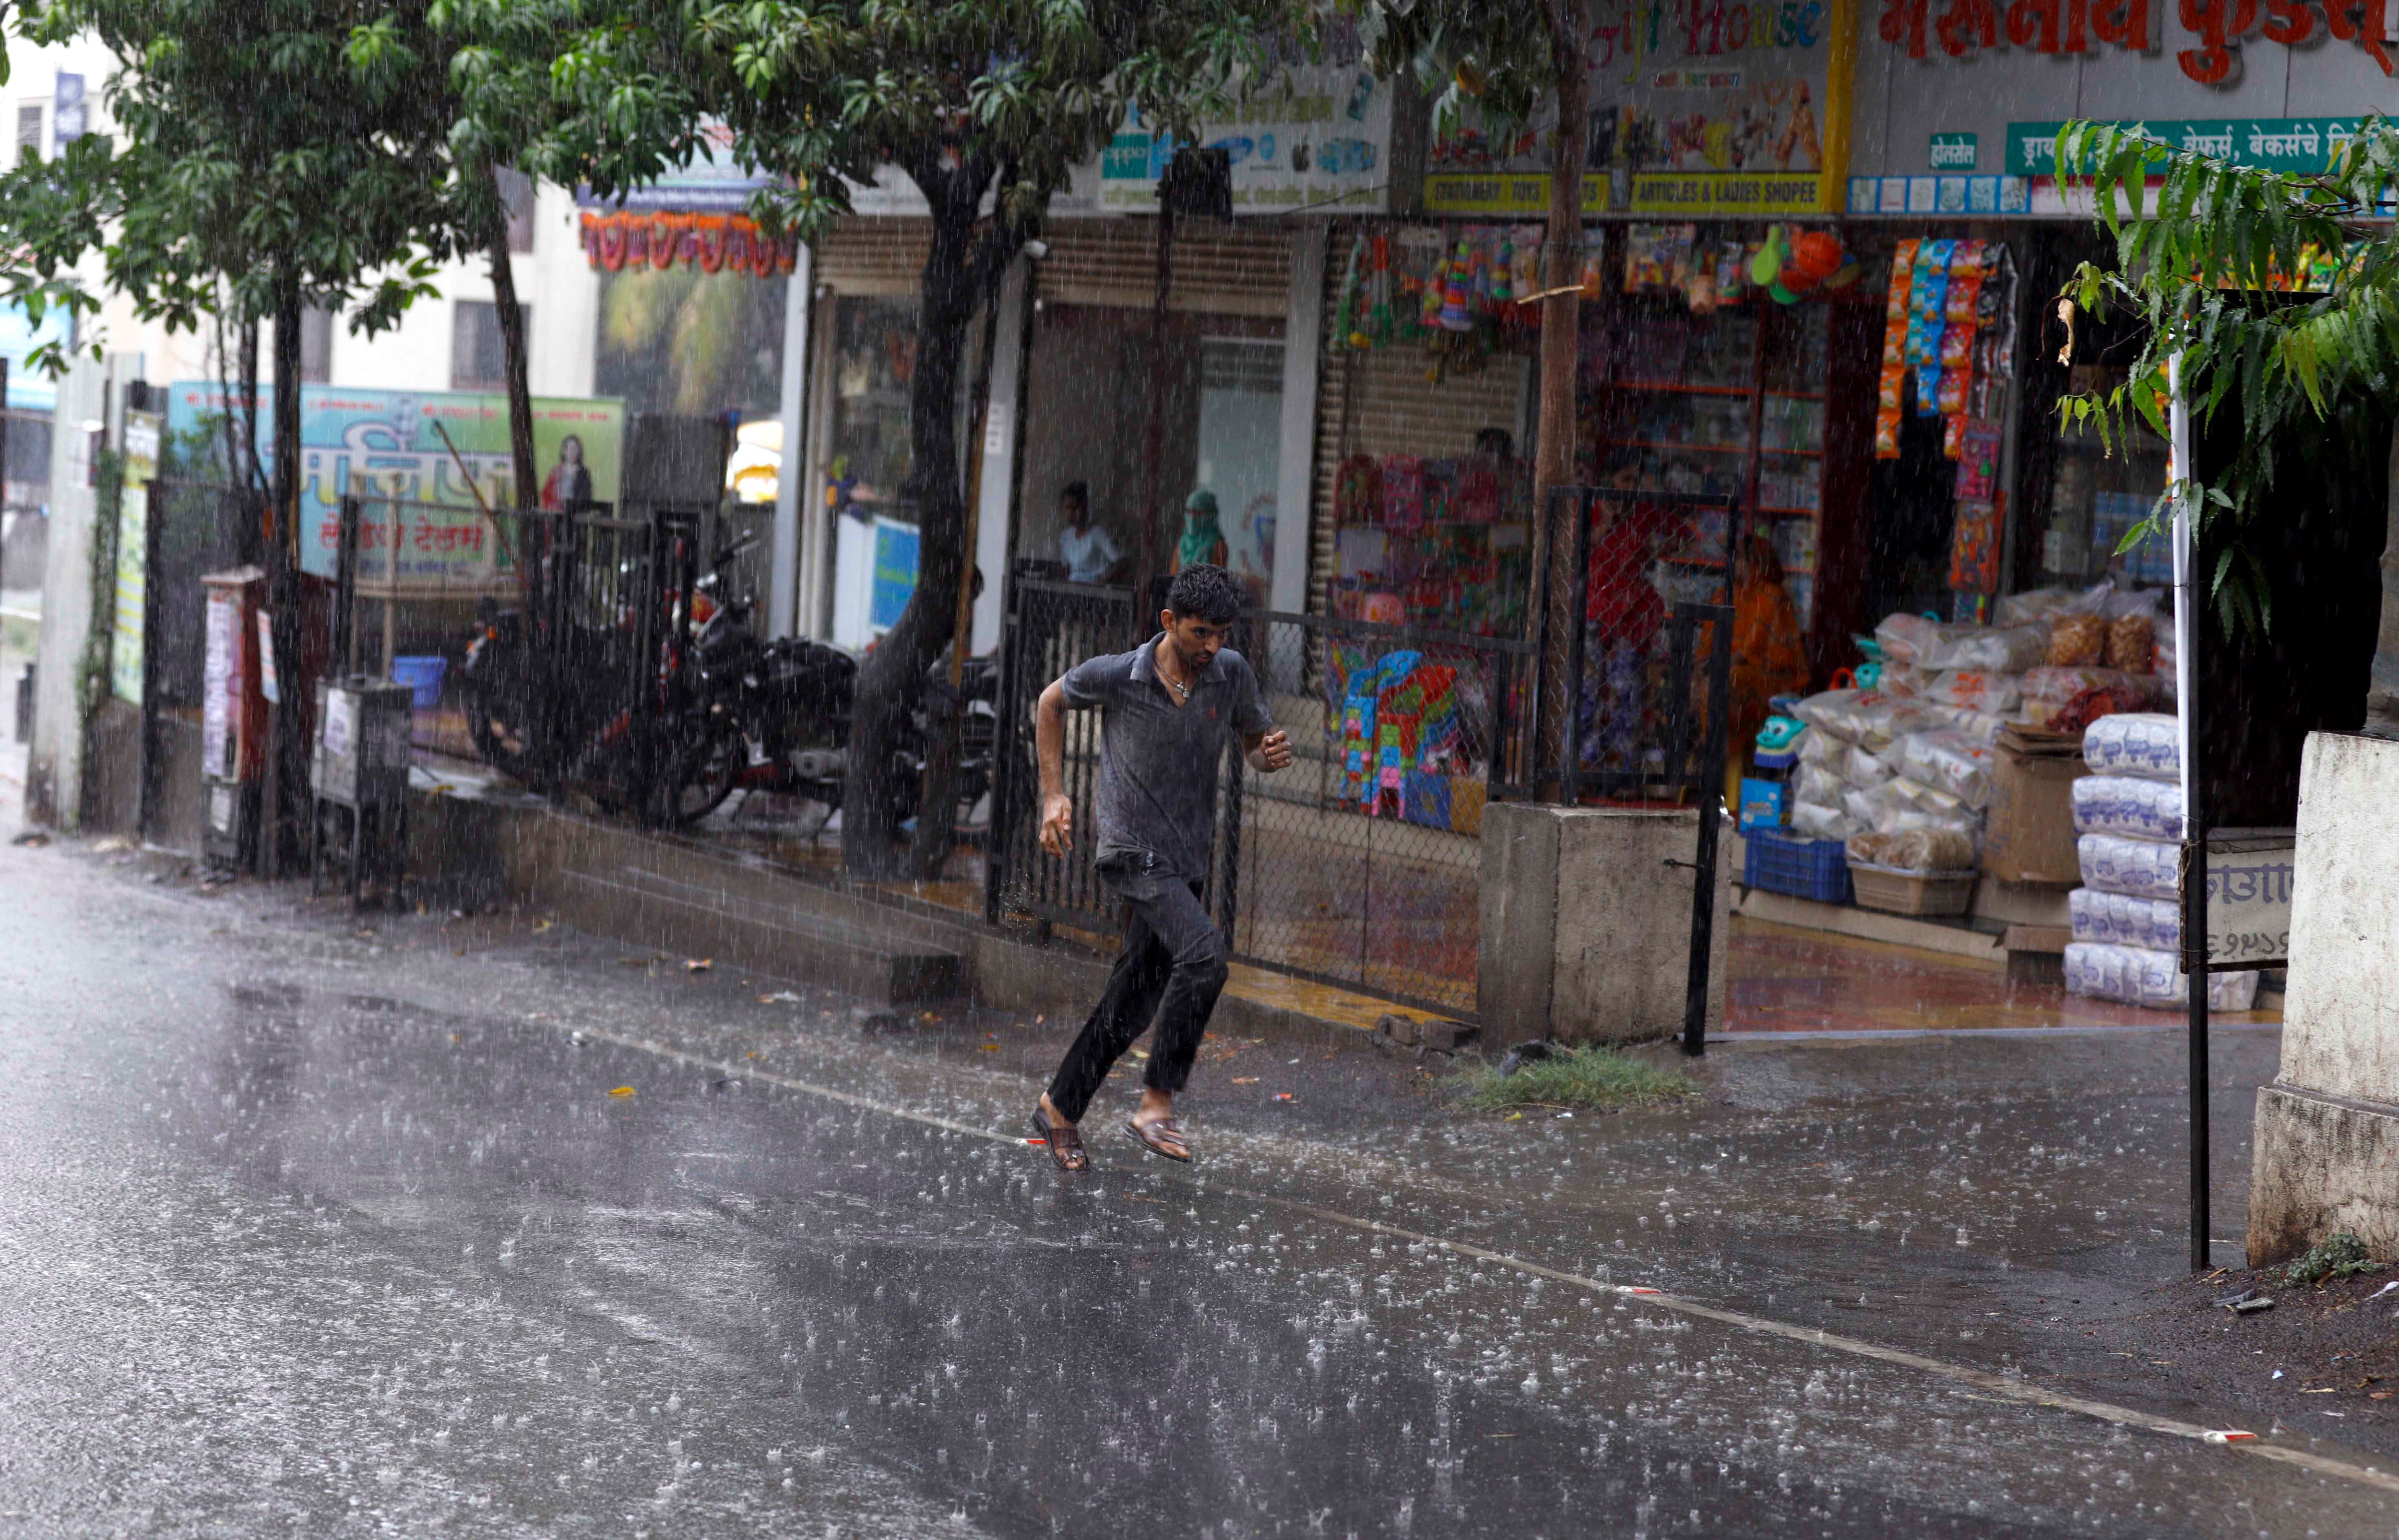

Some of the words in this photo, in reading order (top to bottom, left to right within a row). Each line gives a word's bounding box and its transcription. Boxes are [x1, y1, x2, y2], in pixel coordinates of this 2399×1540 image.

[1639, 182, 1697, 202] ARTICLES
[1715, 182, 1760, 202] LADIES
[1764, 182, 1817, 203] SHOPEE
